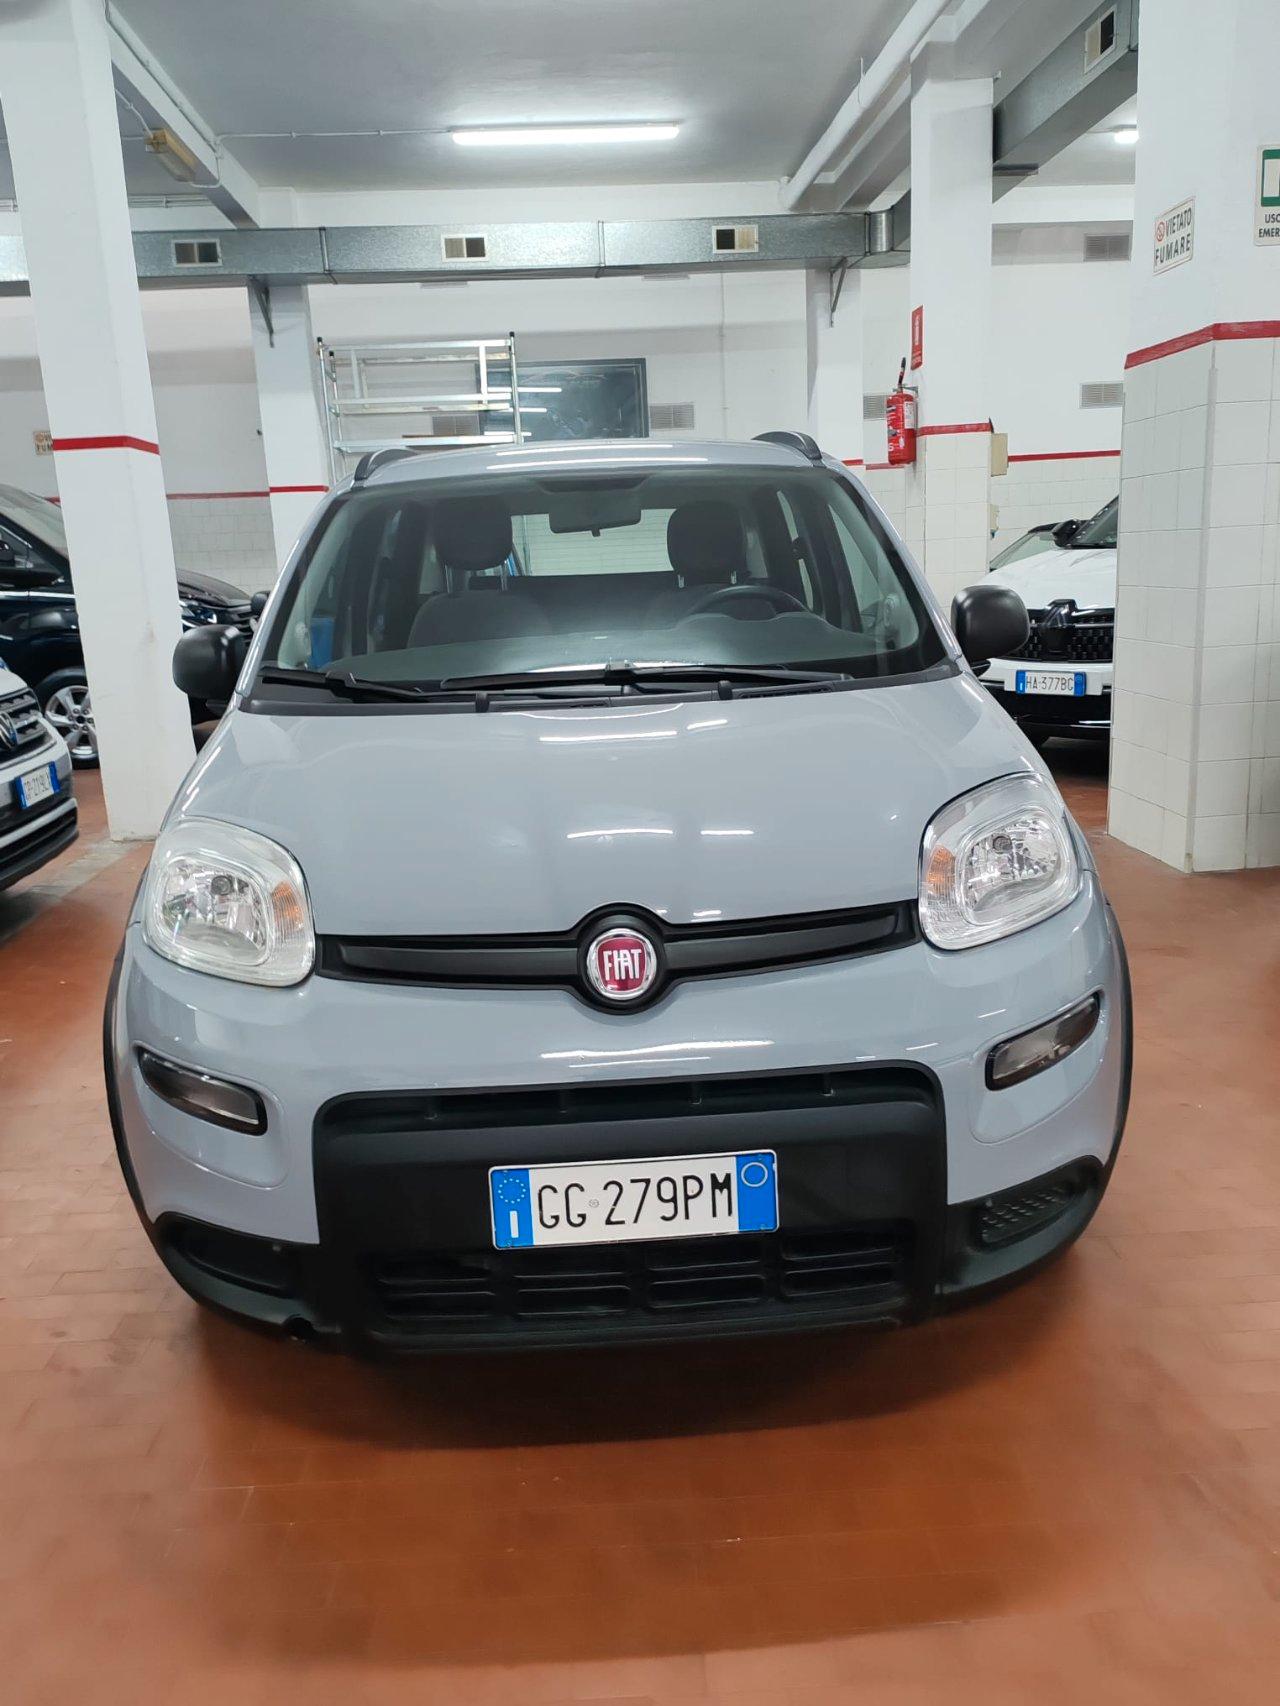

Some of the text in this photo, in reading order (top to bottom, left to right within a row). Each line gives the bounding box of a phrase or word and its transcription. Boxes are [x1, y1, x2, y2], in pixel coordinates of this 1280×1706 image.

[1166, 207, 1192, 236] VIETATO
[1155, 233, 1191, 266] FUMARE
[603, 948, 642, 981] FIAT
